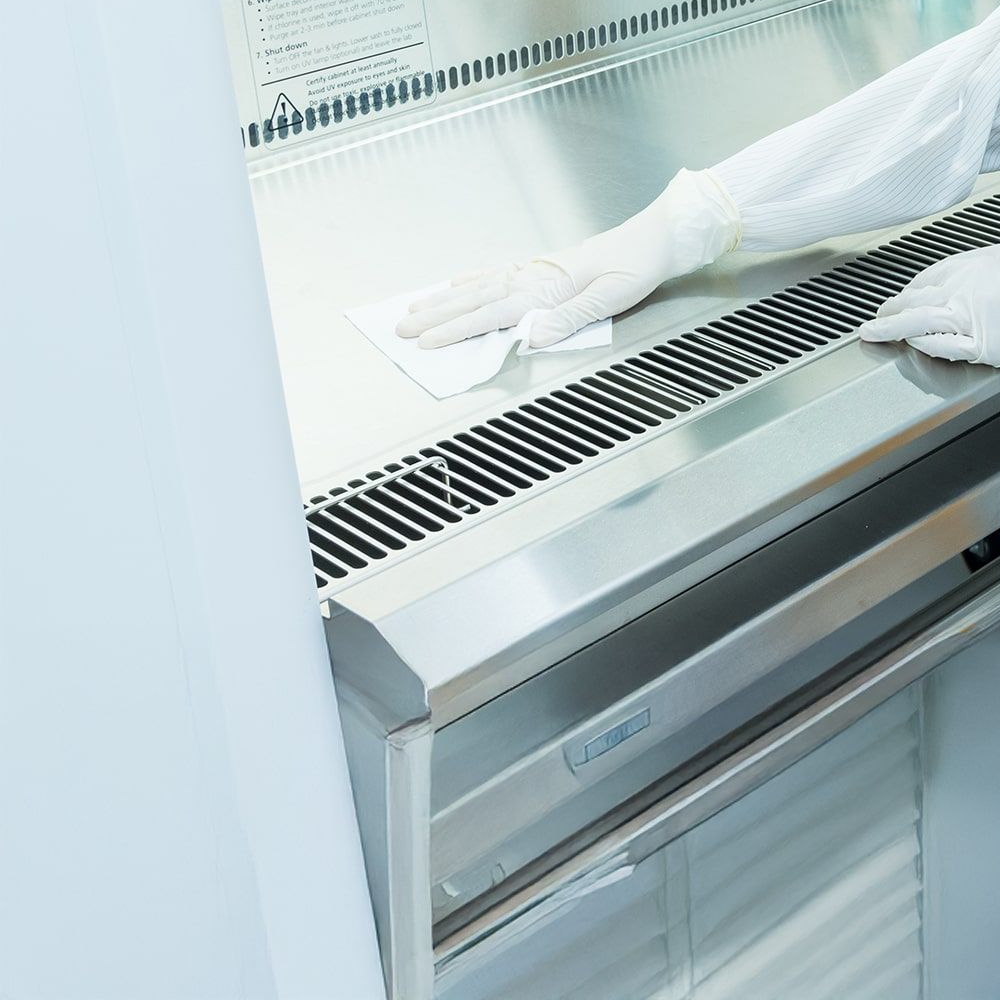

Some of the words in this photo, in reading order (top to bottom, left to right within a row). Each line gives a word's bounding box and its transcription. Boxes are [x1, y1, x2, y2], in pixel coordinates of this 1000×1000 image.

[265, 46, 283, 57] Shut
[285, 41, 307, 51] down
[306, 75, 326, 86] Certify
[327, 69, 349, 80] cabinet
[357, 63, 371, 72] least
[373, 56, 396, 68] annually
[307, 85, 325, 96] Avoid
[326, 83, 335, 91] UV
[337, 76, 363, 88] exposure
[372, 70, 385, 79] eyes
[387, 65, 397, 74] and
[399, 63, 409, 71] skin
[319, 95, 329, 103] not
[360, 80, 386, 92] explosive
